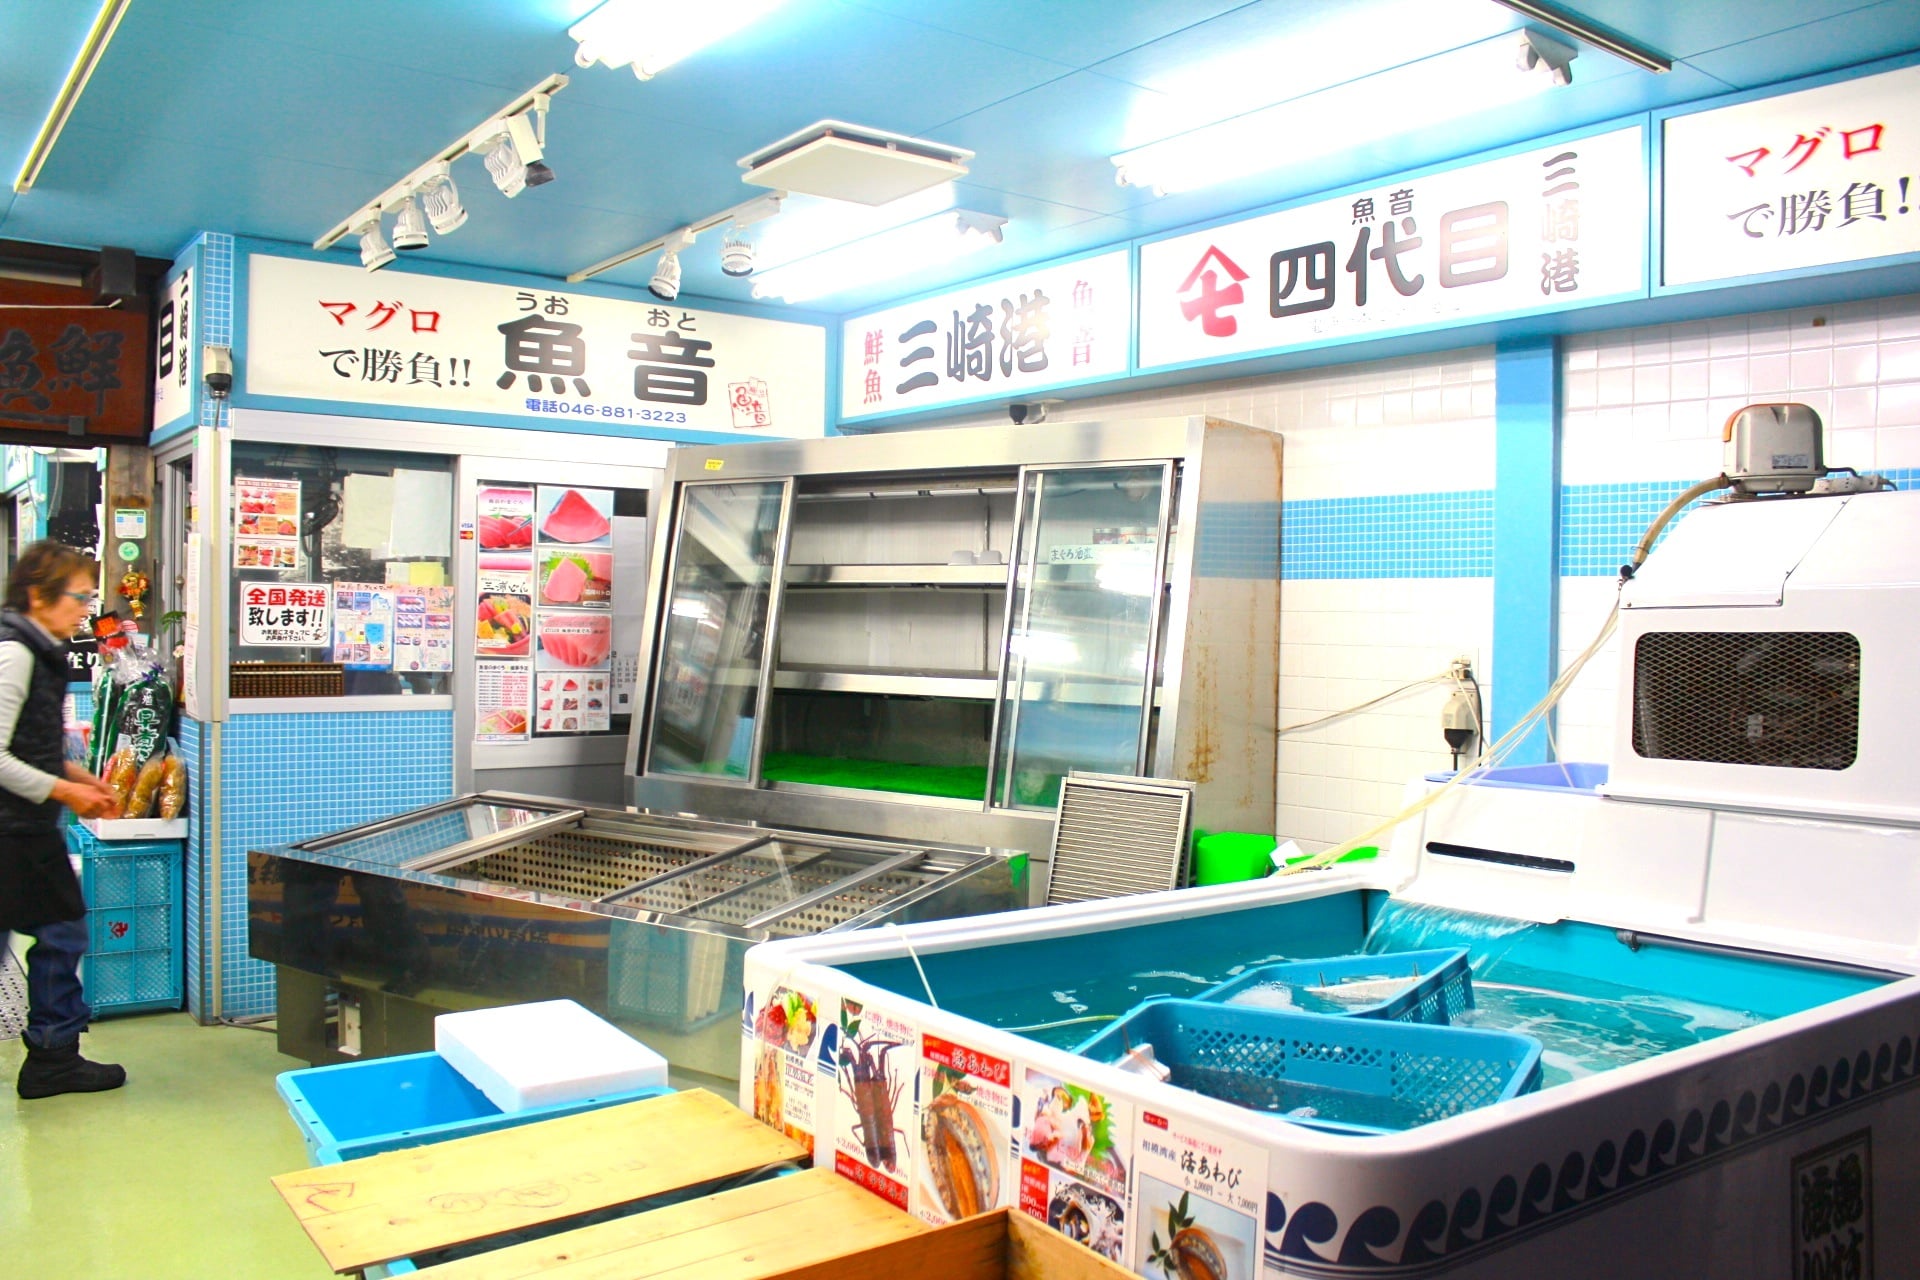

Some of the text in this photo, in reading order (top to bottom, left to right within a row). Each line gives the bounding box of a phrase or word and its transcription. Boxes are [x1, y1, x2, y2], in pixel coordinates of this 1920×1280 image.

[1725, 122, 1887, 179] マグロ
[1350, 189, 1415, 226] 魚音
[1541, 150, 1580, 297] 三崎港
[1725, 175, 1920, 239] で勝負!
[1269, 200, 1510, 319] 四代目
[318, 299, 442, 335] マグロ
[515, 291, 570, 316] うお
[647, 308, 697, 332] おと
[496, 313, 716, 406] 魚音
[896, 288, 1051, 395] 三崎港
[318, 346, 471, 388] で勝負!!
[863, 329, 884, 405] 鮮魚
[525, 398, 687, 424] 電話046-881-3223
[246, 588, 326, 607] 全国発送
[248, 607, 324, 628] 致します!!
[1181, 1149, 1243, 1189] 活あわび
